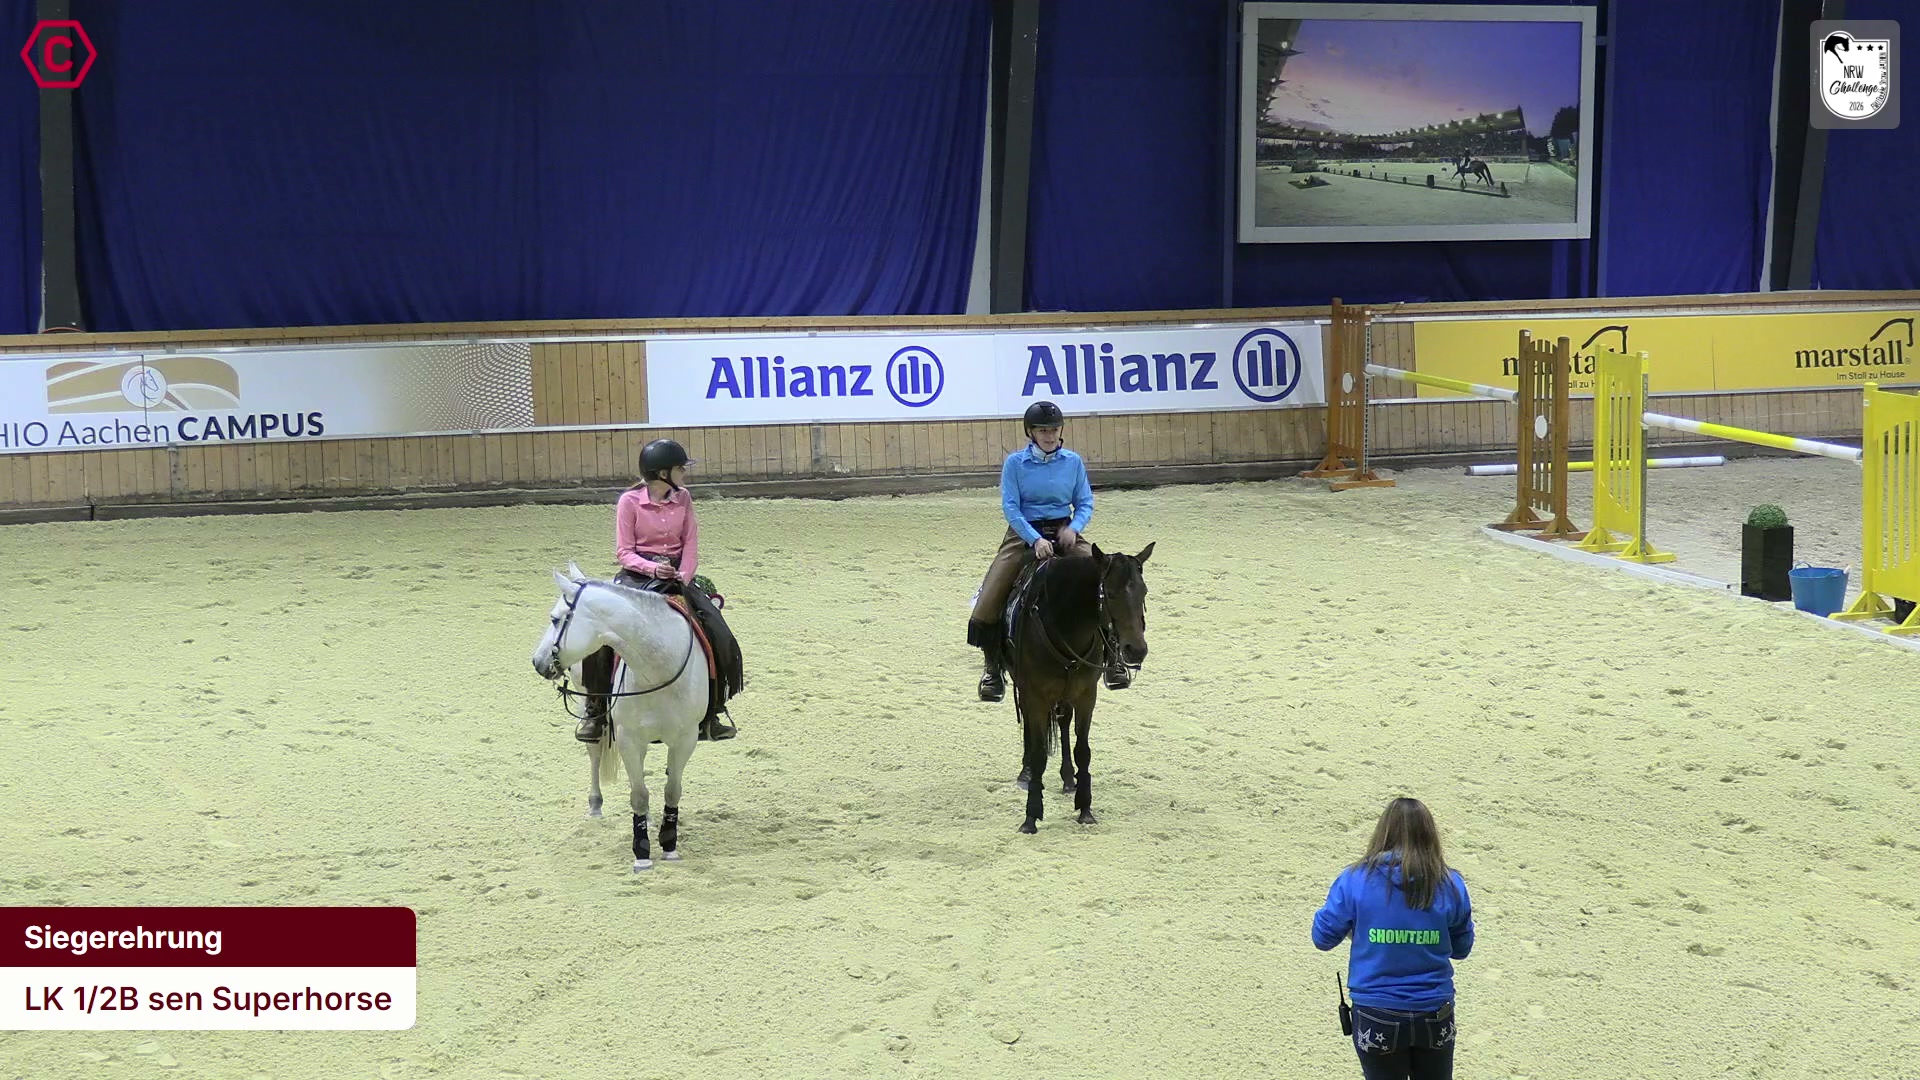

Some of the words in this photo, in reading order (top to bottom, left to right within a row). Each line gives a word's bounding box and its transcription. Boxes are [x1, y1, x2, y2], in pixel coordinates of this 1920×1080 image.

[1022, 343, 1219, 396] Allianz
[1795, 339, 1904, 369] marstall
[706, 356, 874, 399] Allianz
[1836, 372, 1847, 381] Im
[1848, 371, 1867, 380] Stall
[1880, 370, 1905, 379] Hause
[57, 418, 170, 446] Aachen
[177, 411, 324, 442] CAMPUS
[1368, 928, 1440, 945] SHOWTEAM
